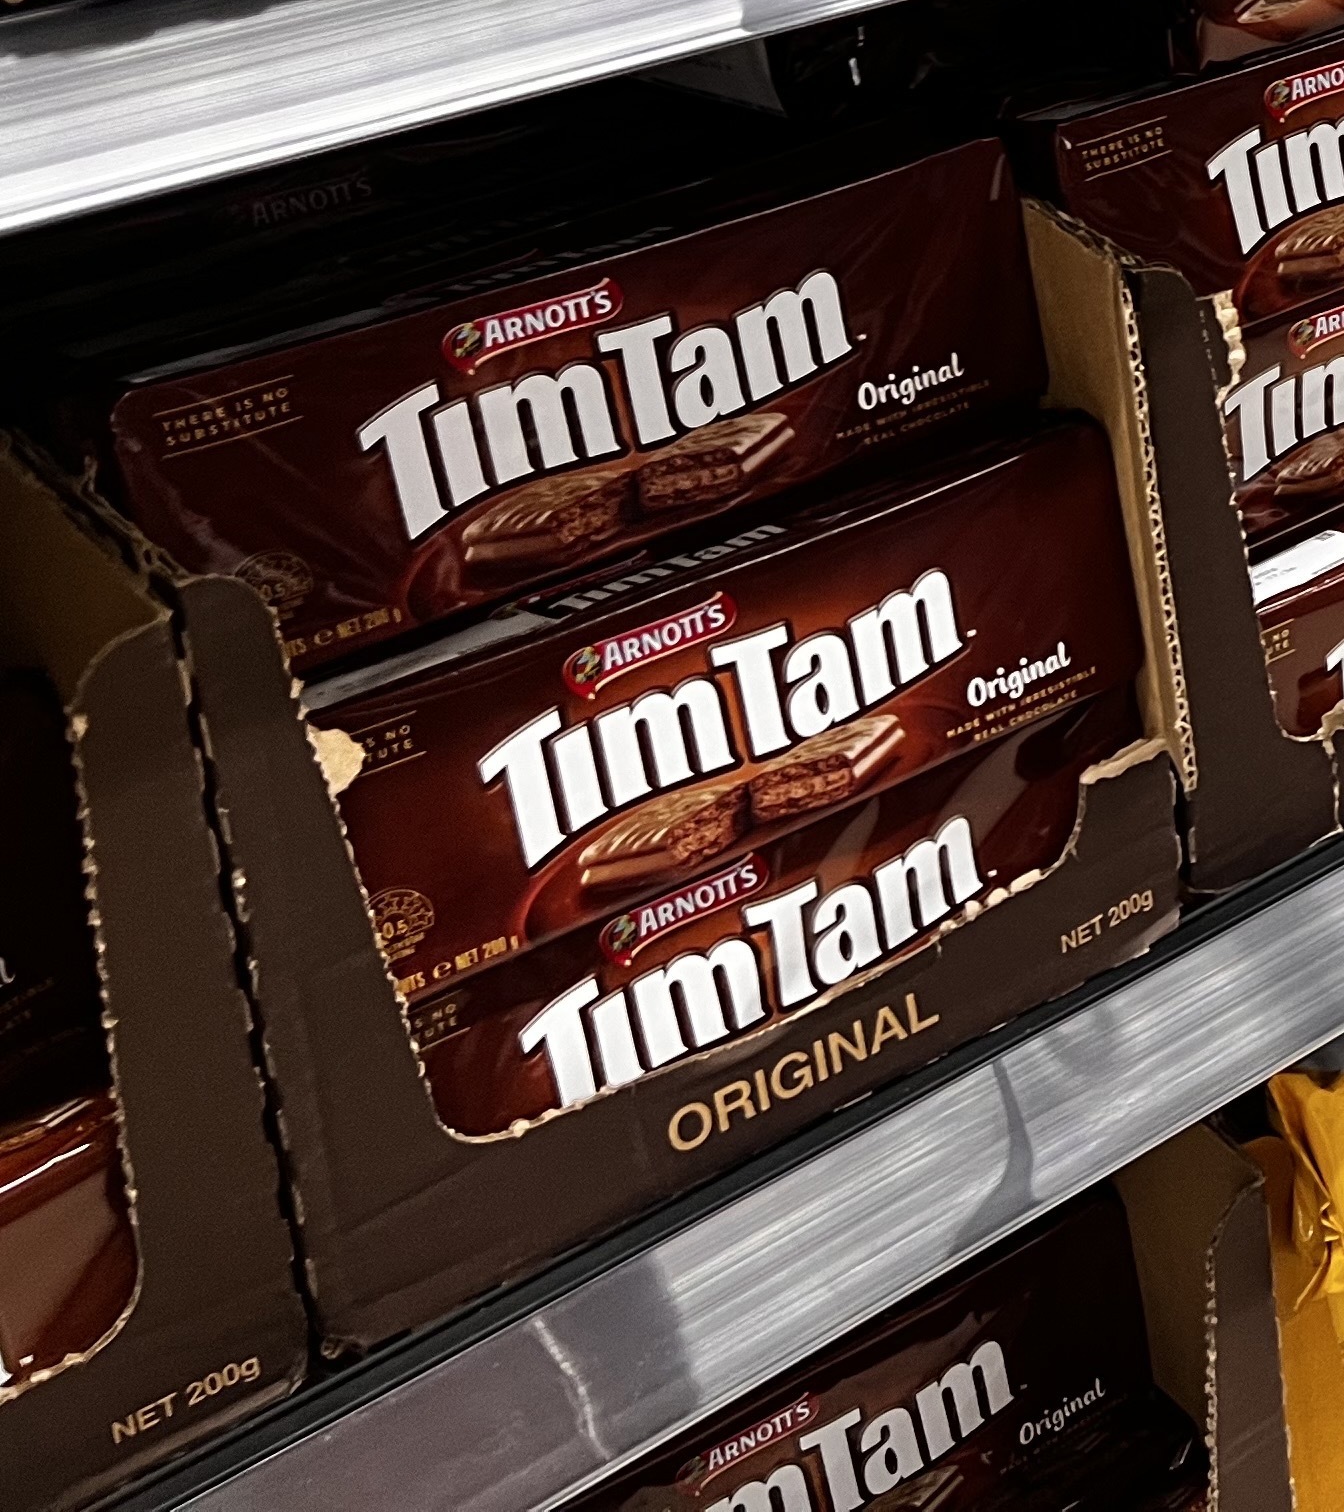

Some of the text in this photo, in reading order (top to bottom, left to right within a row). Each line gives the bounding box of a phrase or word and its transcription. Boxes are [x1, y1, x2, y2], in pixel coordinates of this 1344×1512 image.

[1081, 125, 1165, 162] THERE IS NO
[483, 285, 613, 348] ARNOTT'S
[162, 385, 290, 434] THERE IS NO
[357, 268, 856, 542] TimTam
[855, 351, 964, 414] Original
[602, 598, 726, 670] ARNOTT'S
[965, 640, 1071, 708] Original
[479, 567, 964, 867] TimTam
[946, 700, 1018, 740] MADE WITH
[636, 862, 760, 938] ARNOTT'S
[1058, 888, 1155, 955] NET 200g
[520, 815, 985, 1109] TimTam
[665, 991, 941, 1155] ORIGINAL
[110, 1355, 262, 1444] NET 200g
[706, 1398, 812, 1471] ARNOTT'S
[1017, 1377, 1107, 1446] Original
